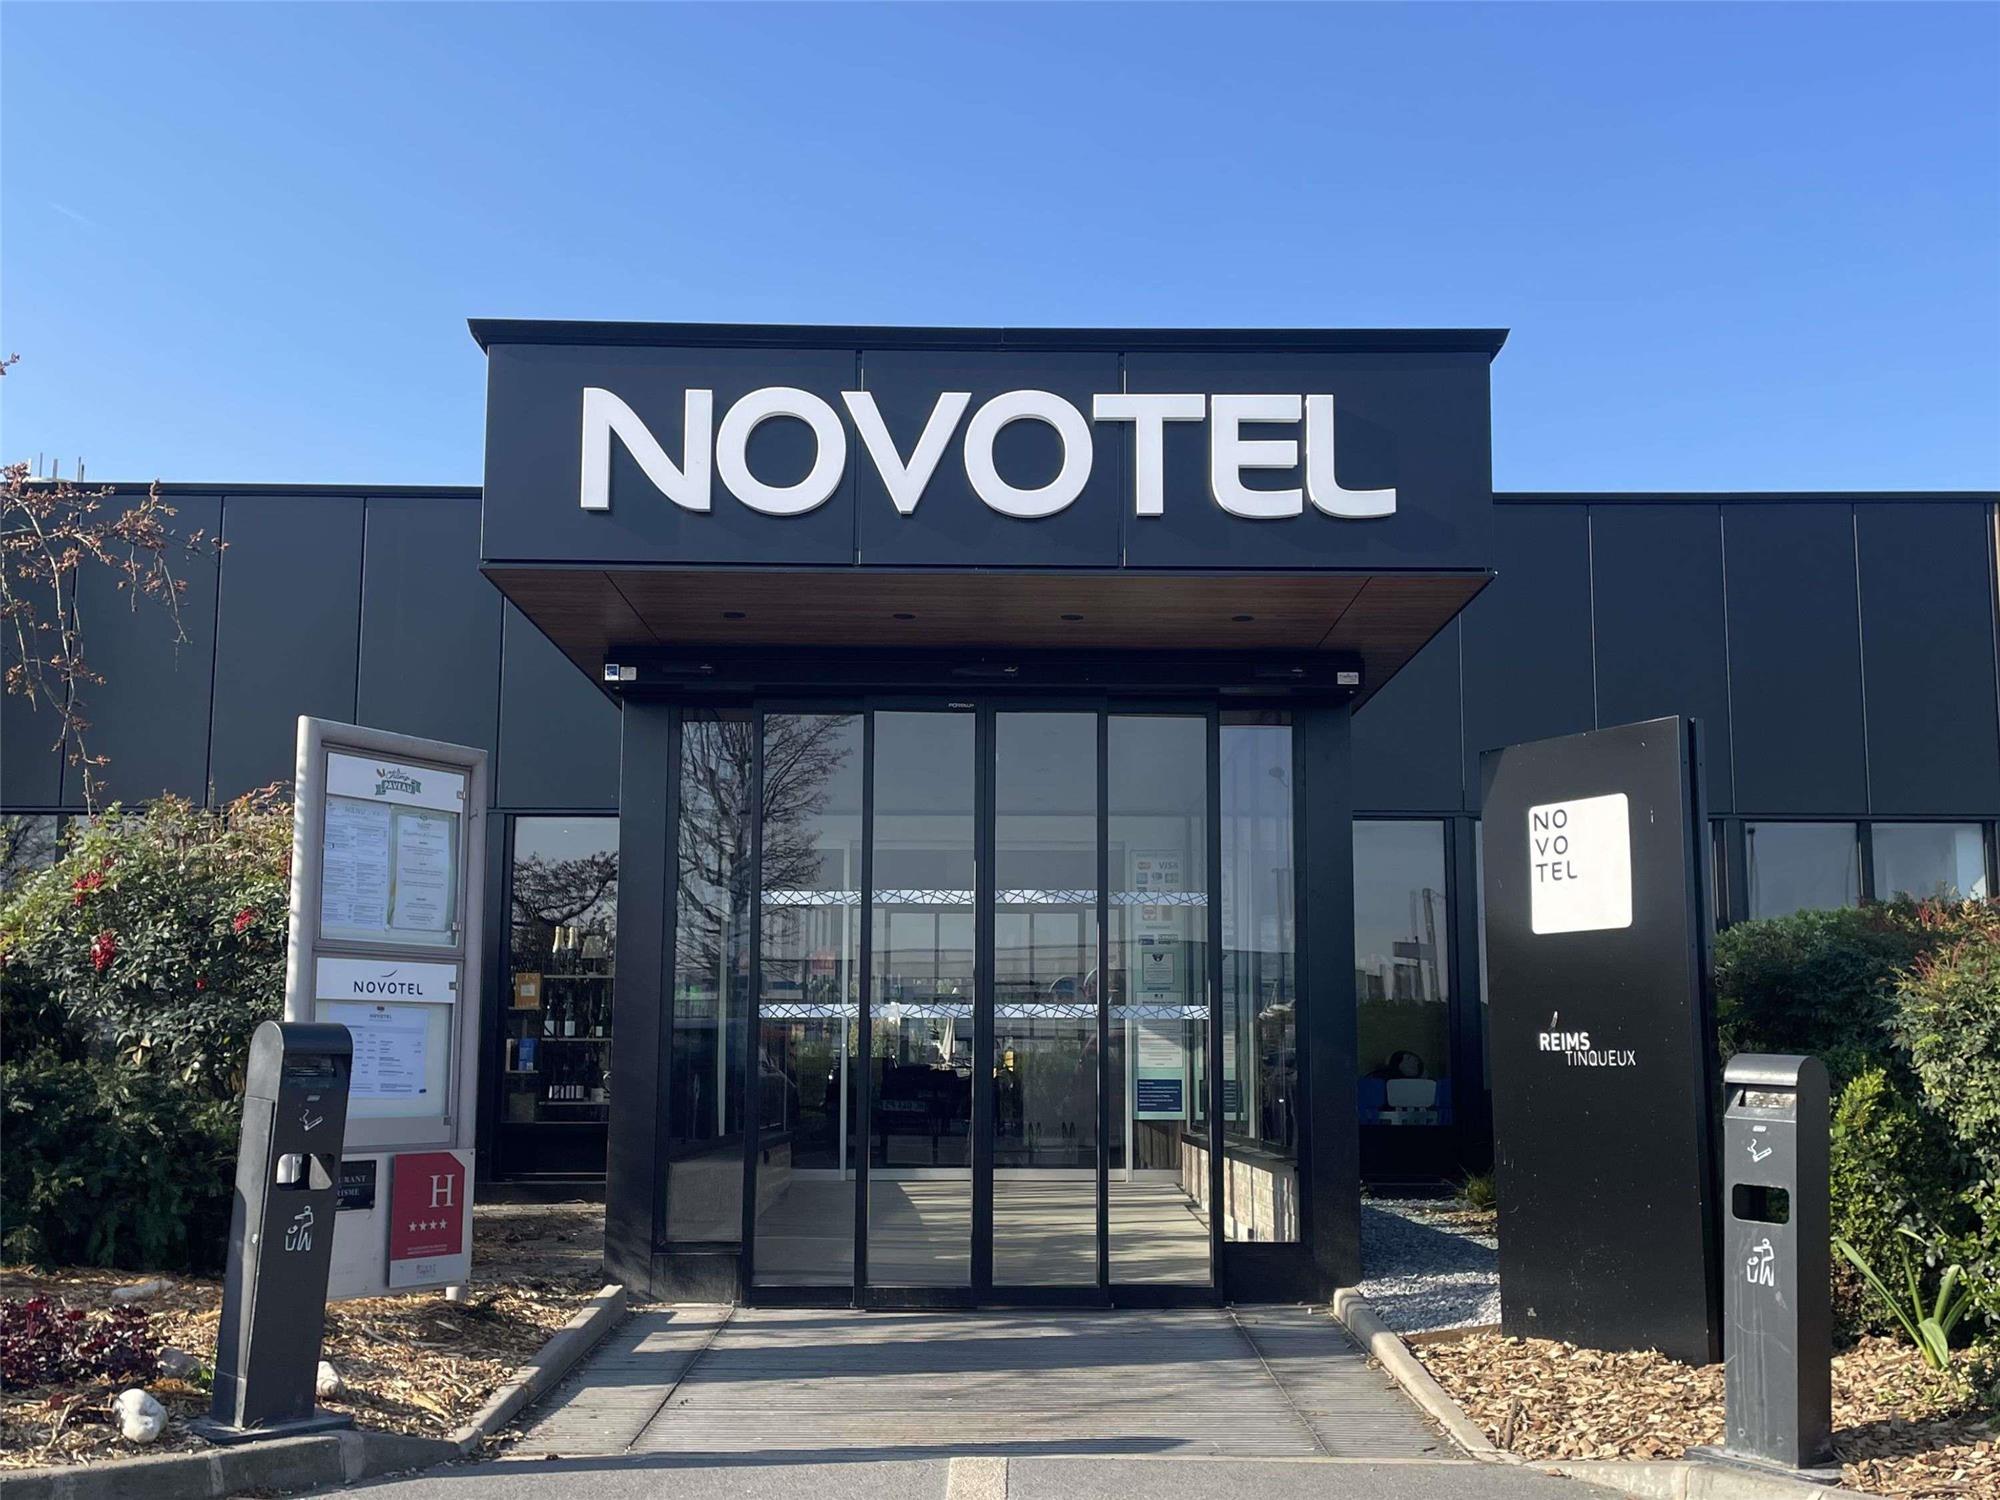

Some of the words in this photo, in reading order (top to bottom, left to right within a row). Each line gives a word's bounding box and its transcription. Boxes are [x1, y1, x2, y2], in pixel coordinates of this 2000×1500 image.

[580, 386, 1397, 518] NOVOTEL
[1534, 809, 1567, 831] NO
[1535, 835, 1568, 857] VO
[1536, 860, 1578, 882] TEL
[353, 981, 424, 995] NOVOTEL
[1540, 1031, 1591, 1051] REIMS
[1565, 1049, 1636, 1066] TINQUEUX
[428, 1173, 456, 1208] H
